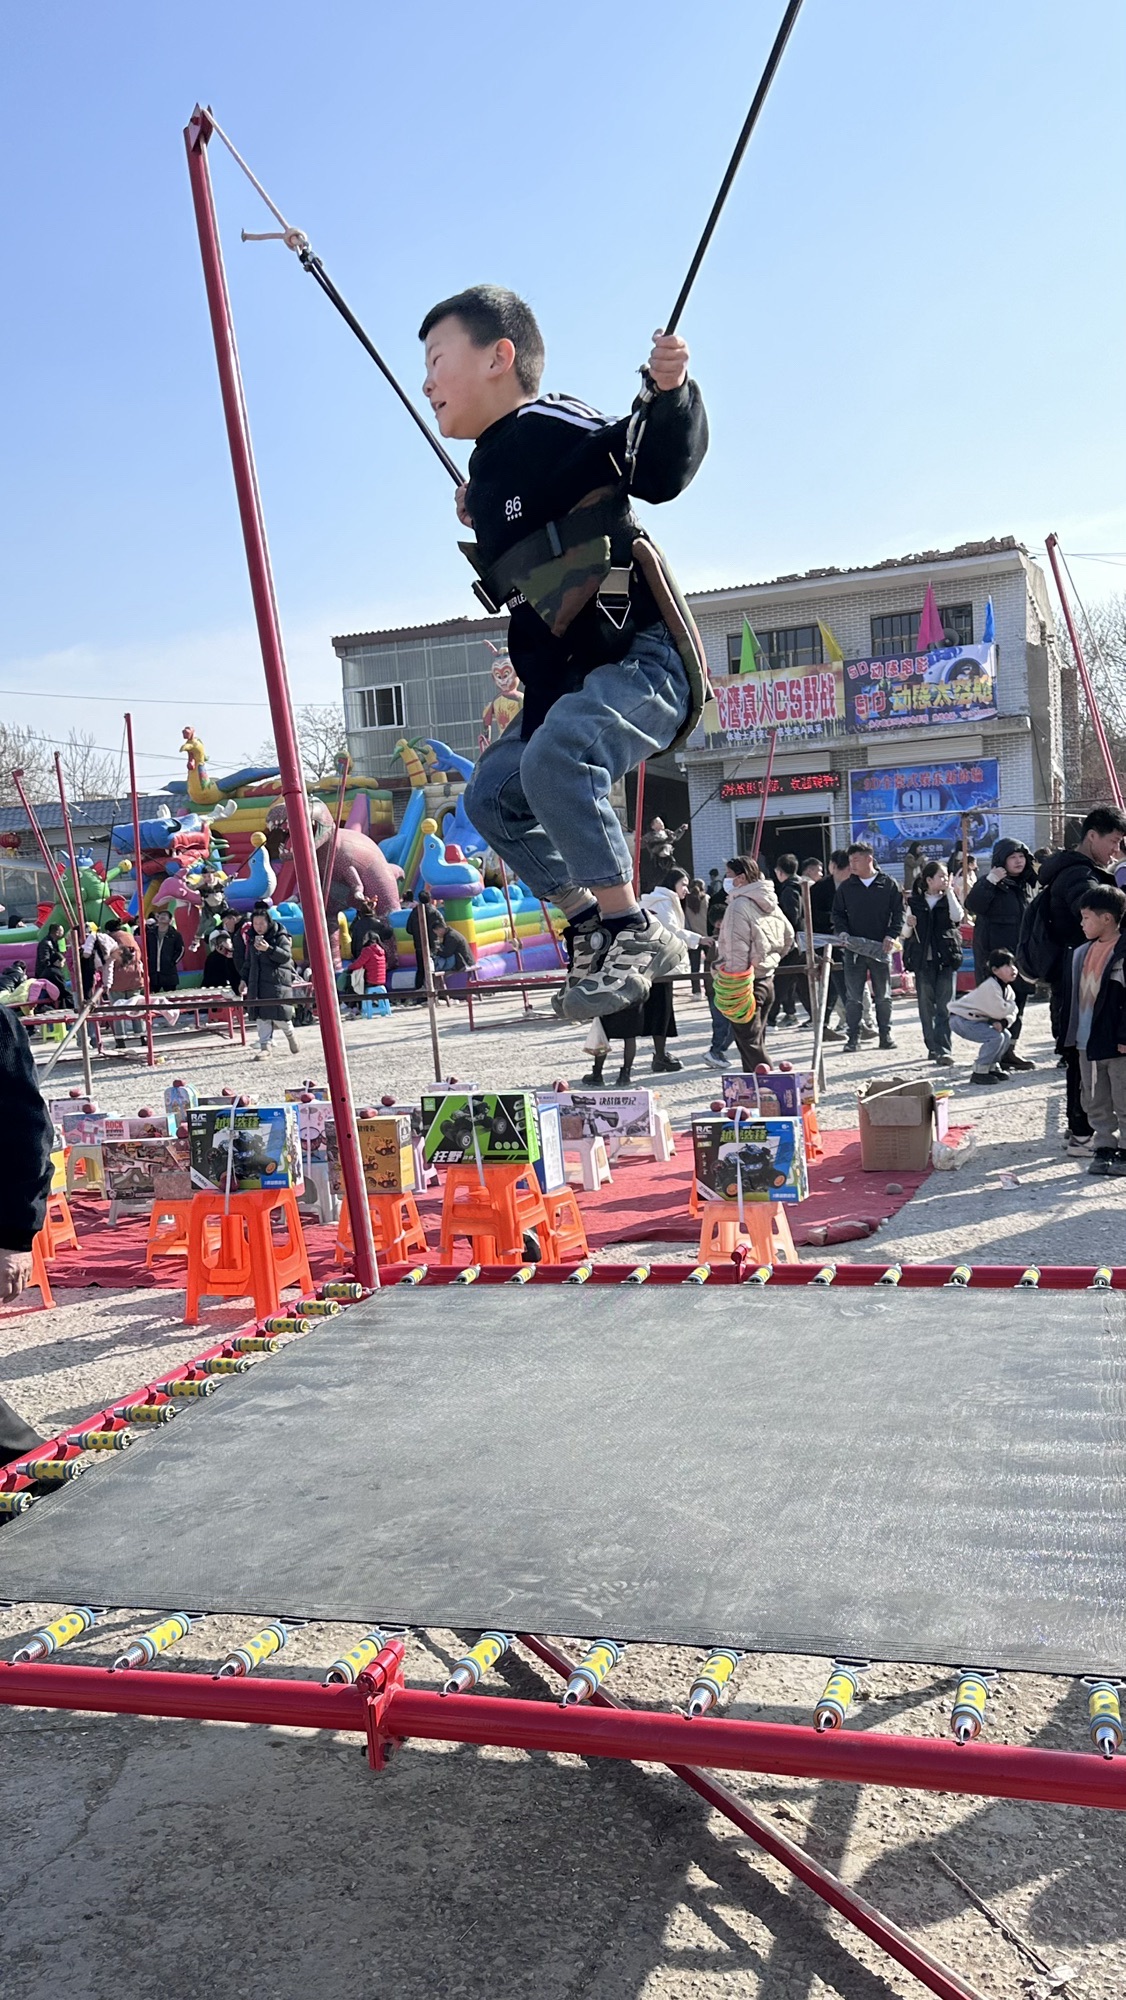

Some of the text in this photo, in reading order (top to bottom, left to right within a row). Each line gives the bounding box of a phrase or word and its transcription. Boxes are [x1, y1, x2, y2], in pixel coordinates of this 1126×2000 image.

[505, 496, 521, 515] 86
[713, 672, 838, 730] 飞鹰真人CS野战
[901, 789, 941, 812] 9D
[599, 1096, 637, 1106] 决战侏罗纪
[190, 1113, 207, 1121] R/C
[105, 1120, 123, 1129] ROCK
[696, 1125, 713, 1133] R/C
[432, 1150, 463, 1163] 狂野
